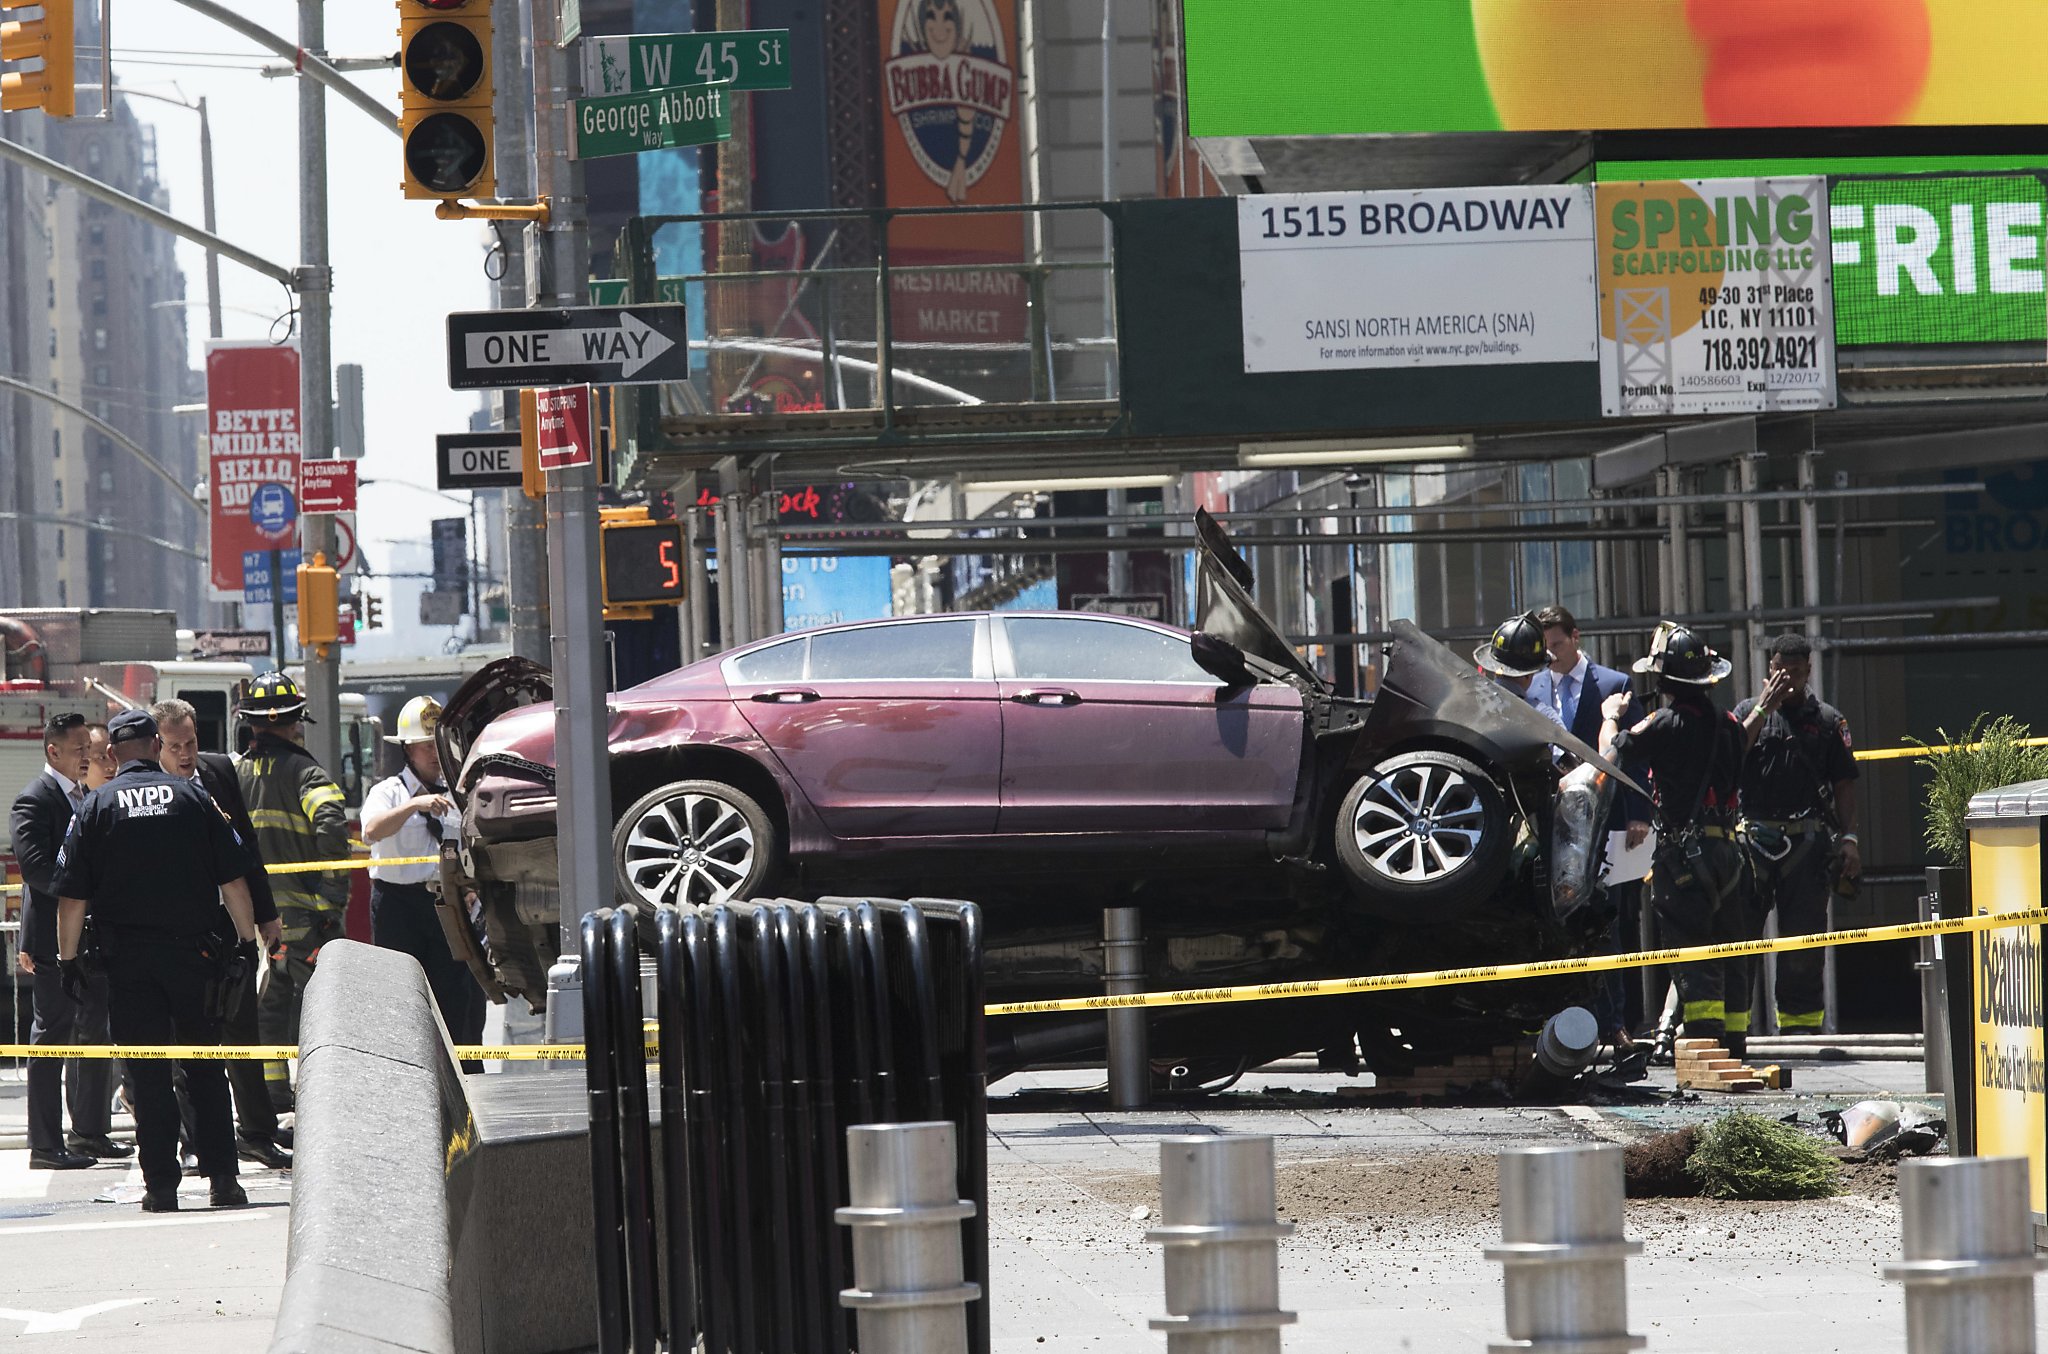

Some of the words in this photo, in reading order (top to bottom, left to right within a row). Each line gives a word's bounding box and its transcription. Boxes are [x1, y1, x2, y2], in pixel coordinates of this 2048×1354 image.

[640, 44, 672, 86] W
[695, 40, 738, 84] 45
[759, 38, 782, 67] St
[890, 63, 954, 107] BUBBA
[957, 58, 1010, 111] GUMP
[584, 102, 650, 137] George
[659, 88, 722, 125] Abbott
[643, 129, 663, 147] Way
[1261, 205, 1347, 239] 1515
[1359, 196, 1572, 236] BROADWAY
[1611, 194, 1814, 251] SPRING
[1611, 248, 1771, 277] SCAFFOLDING
[1777, 248, 1814, 271] LLC
[663, 284, 681, 304] St
[893, 271, 1020, 295] RESTAURANT
[1699, 287, 1741, 305] 49-30
[1747, 284, 1771, 304] 31st
[1774, 284, 1815, 303] Place
[917, 308, 1000, 334] MARKET
[1305, 319, 1350, 340] SANSI
[1356, 317, 1410, 338] NORTH
[1415, 314, 1488, 337] AMERICA
[1493, 311, 1535, 337] (SNA)
[1701, 308, 1735, 330] LIC,
[1741, 308, 1762, 328] NY
[1768, 306, 1816, 328] 11101
[483, 333, 550, 364] ONE
[582, 330, 651, 361] WAY
[1320, 347, 1333, 359] For
[1335, 348, 1356, 359] more
[1357, 344, 1406, 357] information
[1407, 344, 1424, 356] visit
[1703, 336, 1817, 372] 718.392.4921
[1621, 383, 1657, 397] Permit
[1659, 383, 1677, 396] No.
[1679, 374, 1742, 388] 140586603
[1769, 371, 1820, 386] 12/20/17
[540, 398, 549, 413] NO
[550, 393, 577, 412] STOPPING
[216, 408, 295, 433] BETTE
[540, 415, 566, 433] Anytime
[211, 432, 301, 457] MIDLER
[218, 459, 297, 484] HELLO,
[304, 465, 313, 475] NO
[315, 464, 348, 475] STANDING
[461, 450, 511, 473] ONE
[304, 478, 332, 490] Anytime
[659, 540, 680, 588] 5
[116, 785, 175, 809] NYPD
[128, 803, 165, 813] EMERGENCY
[128, 810, 154, 818] SERVICE
[154, 808, 169, 816] UNIT
[1980, 1040, 1994, 1089] The
[1994, 1042, 2012, 1091] Carole
[2013, 1044, 2026, 1104] King
